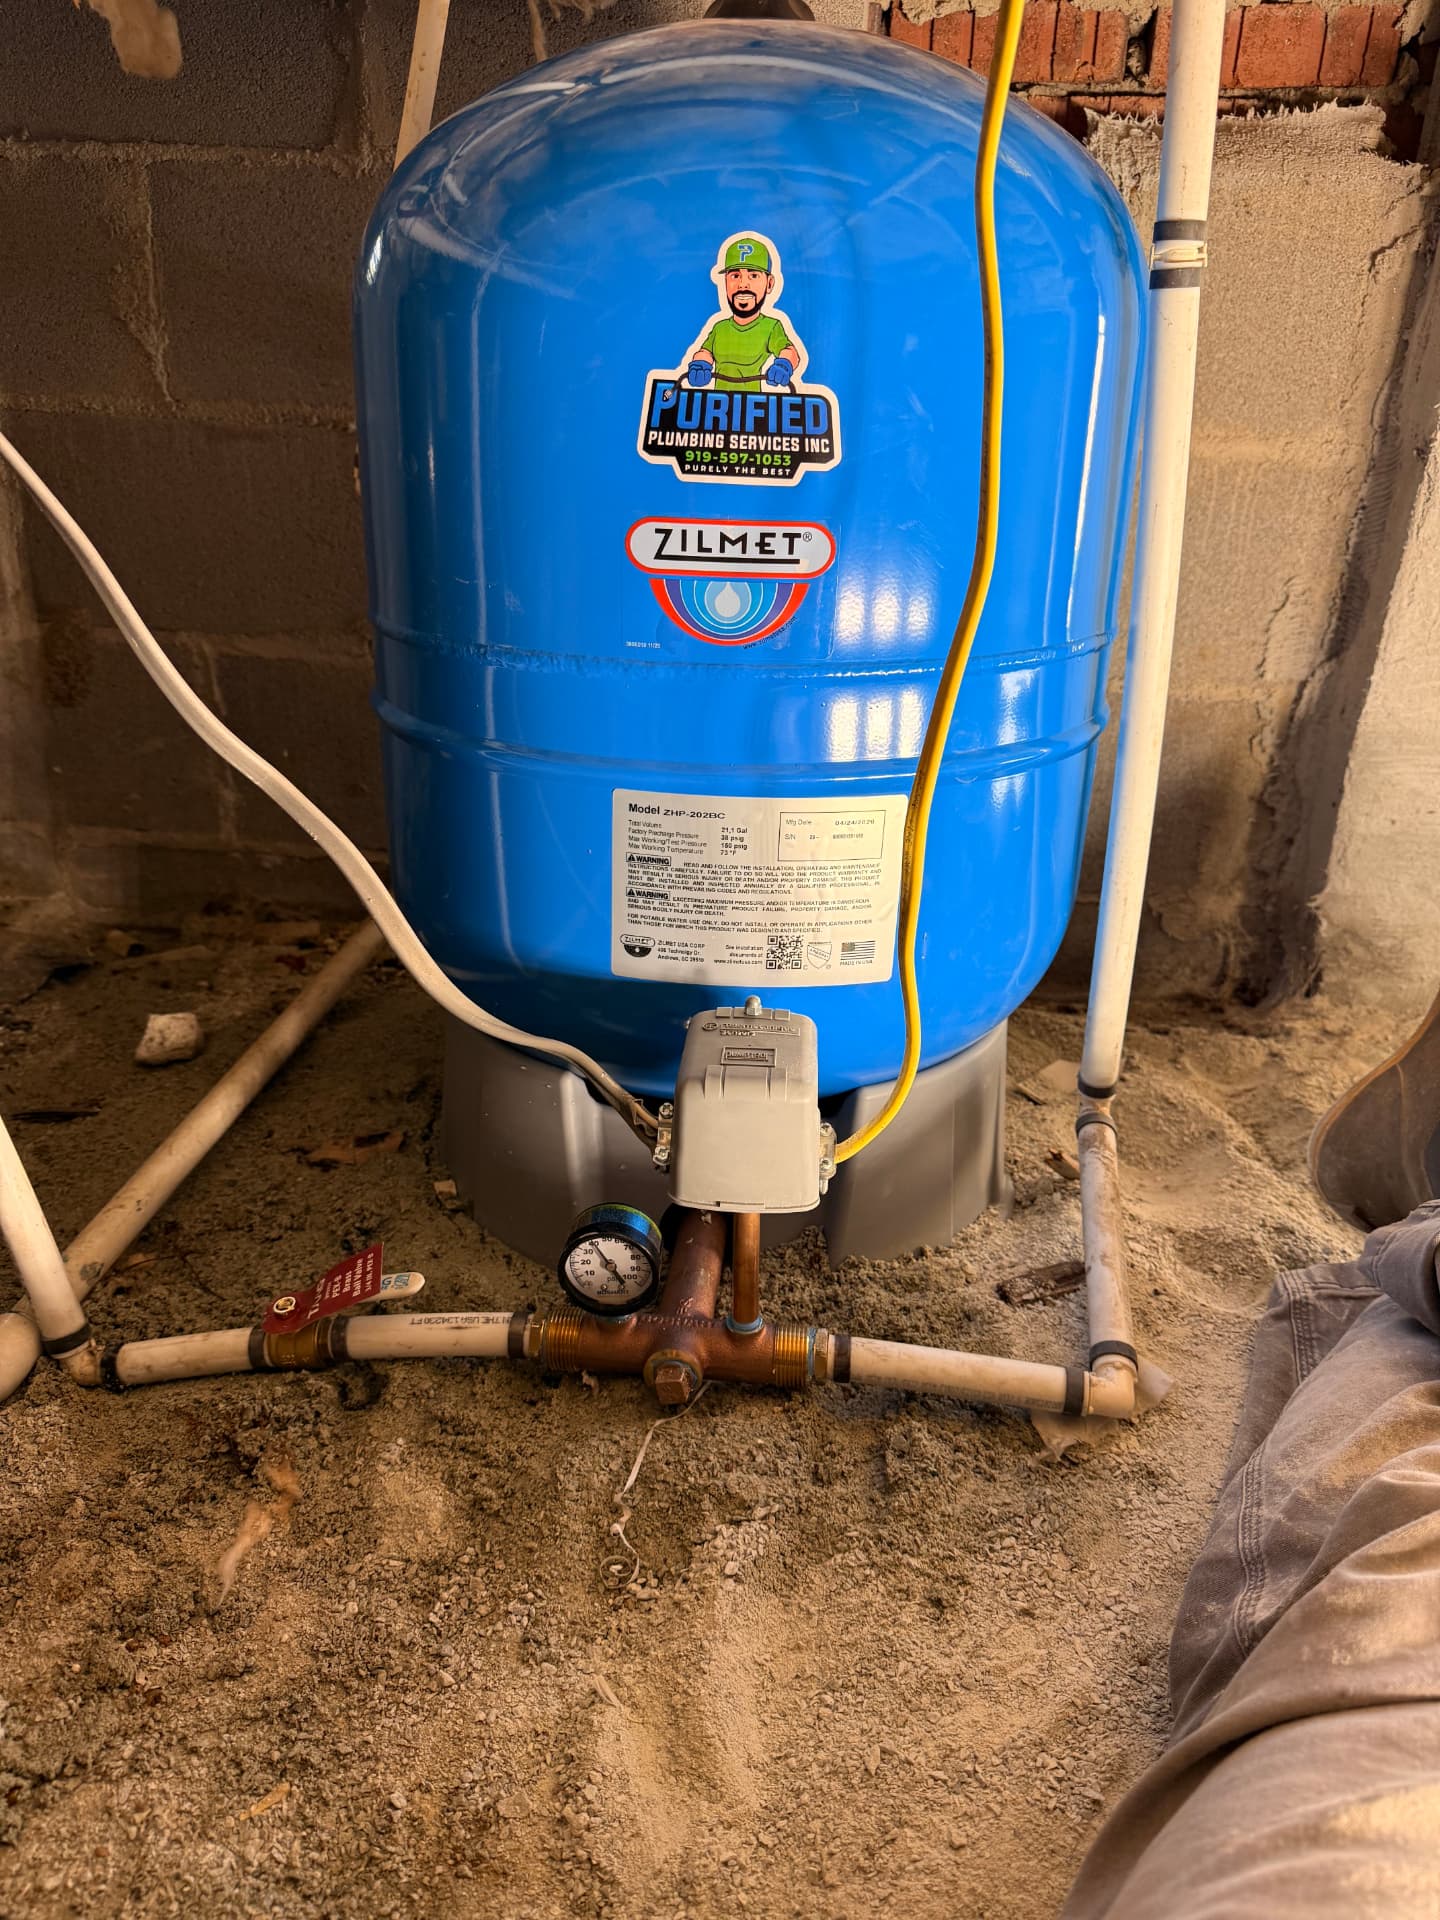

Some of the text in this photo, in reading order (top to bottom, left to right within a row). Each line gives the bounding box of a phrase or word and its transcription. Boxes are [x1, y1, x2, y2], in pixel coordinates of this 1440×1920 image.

[737, 244, 754, 262] P
[650, 382, 828, 435] PURIFIED
[648, 430, 830, 454] PLUMBING SERVICES INC
[685, 450, 792, 467] 919-597-1053
[684, 464, 791, 476] PURELY THE BEST
[628, 803, 726, 819] Model ZHP-202BC
[628, 827, 647, 835] Factory
[641, 844, 665, 852] Working
[636, 856, 670, 865] WARNING
[628, 863, 669, 872] INSTRUCTIONS
[628, 880, 666, 889] ACCORDANCE
[635, 889, 669, 900] WARNING
[628, 903, 652, 911] SERIOUS
[624, 936, 650, 944] ZILMET
[409, 1317, 423, 1325] FT
[460, 1316, 480, 1325] USA
